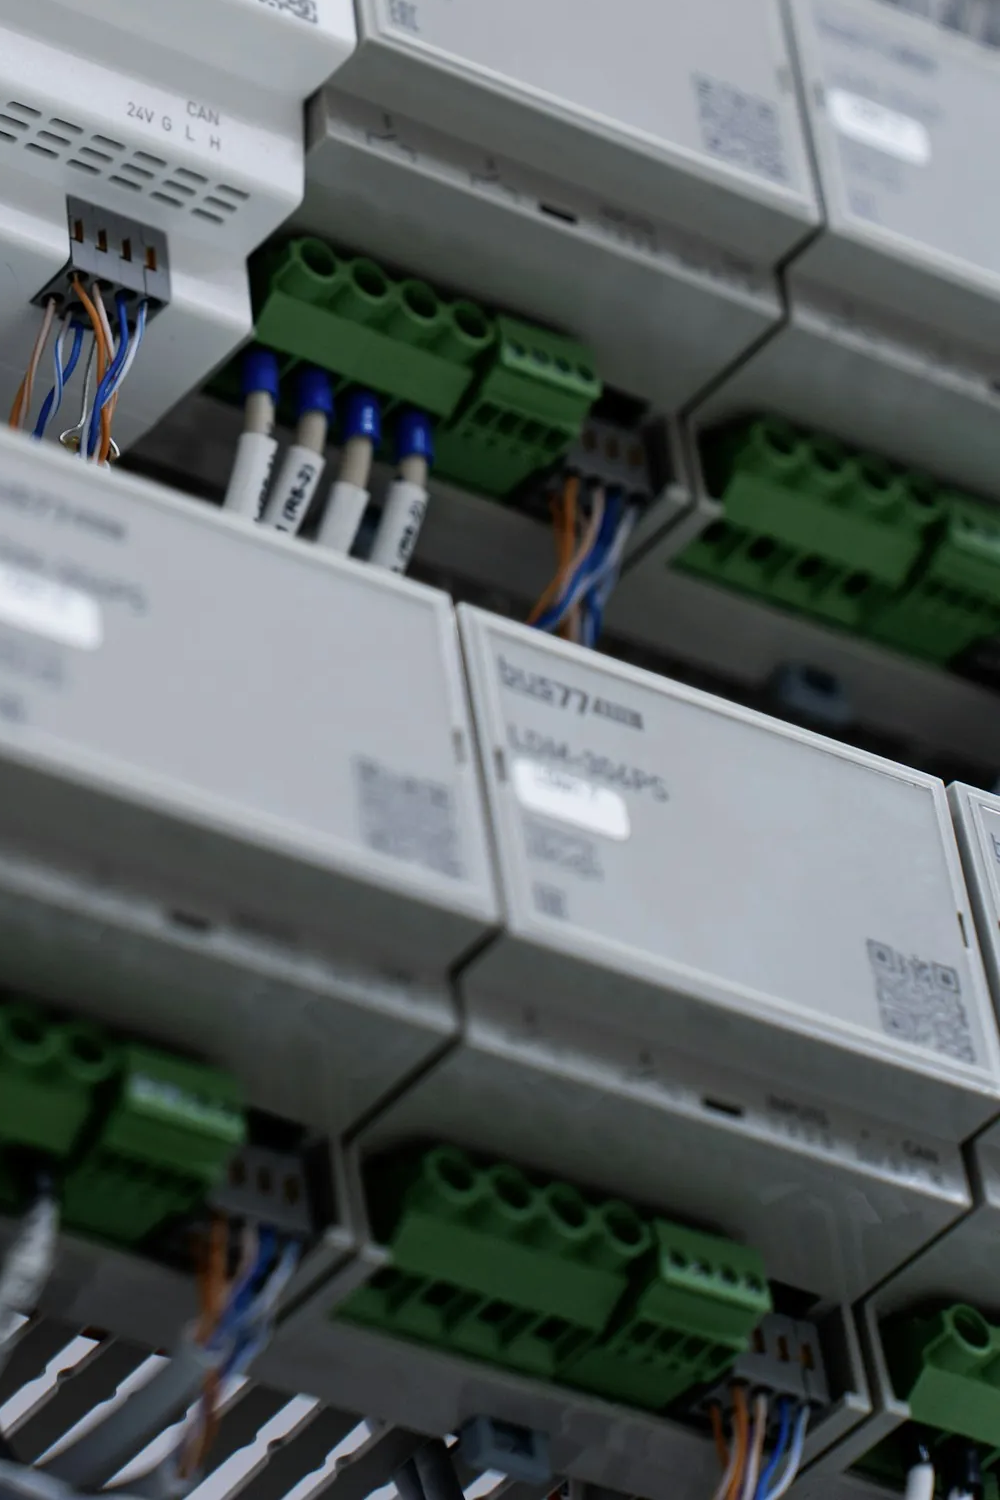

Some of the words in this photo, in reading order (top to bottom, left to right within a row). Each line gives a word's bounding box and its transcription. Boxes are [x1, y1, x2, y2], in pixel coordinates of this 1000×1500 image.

[127, 101, 154, 124] 24V
[161, 116, 172, 132] G
[186, 124, 196, 142] L
[209, 134, 220, 152] H
[187, 100, 220, 127] CAN
